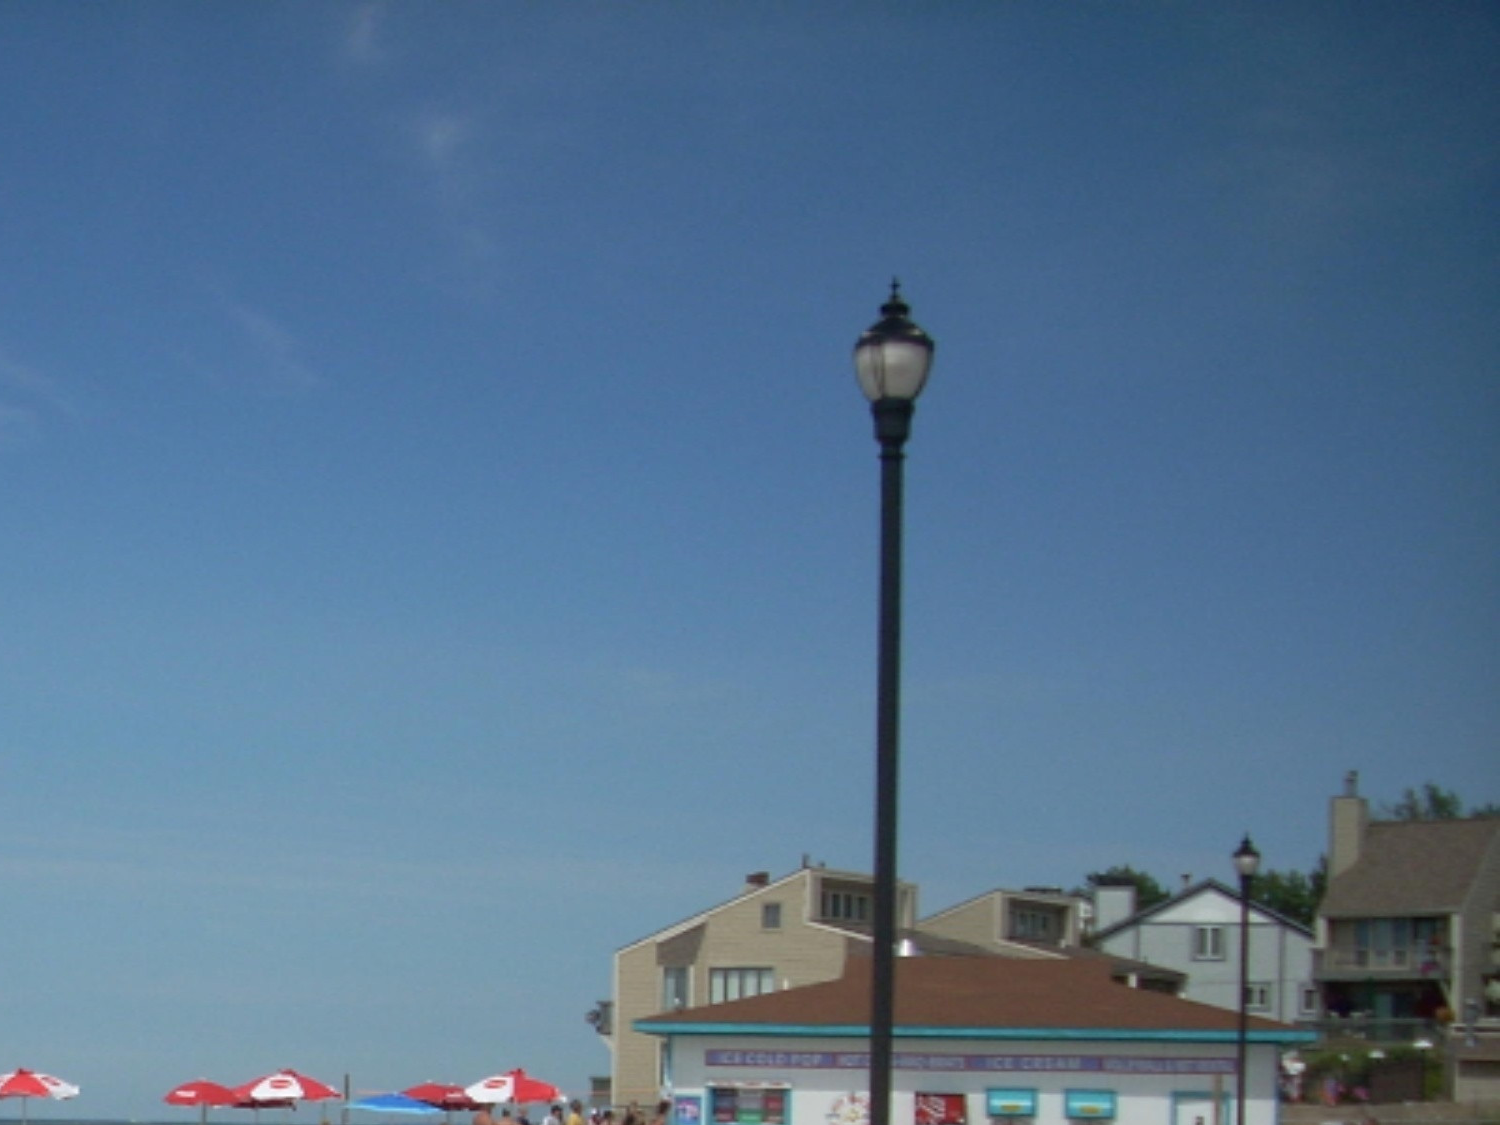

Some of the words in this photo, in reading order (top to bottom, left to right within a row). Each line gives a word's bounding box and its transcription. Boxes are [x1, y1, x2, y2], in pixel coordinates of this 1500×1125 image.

[745, 1053, 788, 1066] COLD
[985, 1056, 1014, 1069] ICE
[1020, 1056, 1082, 1070] CREAM
